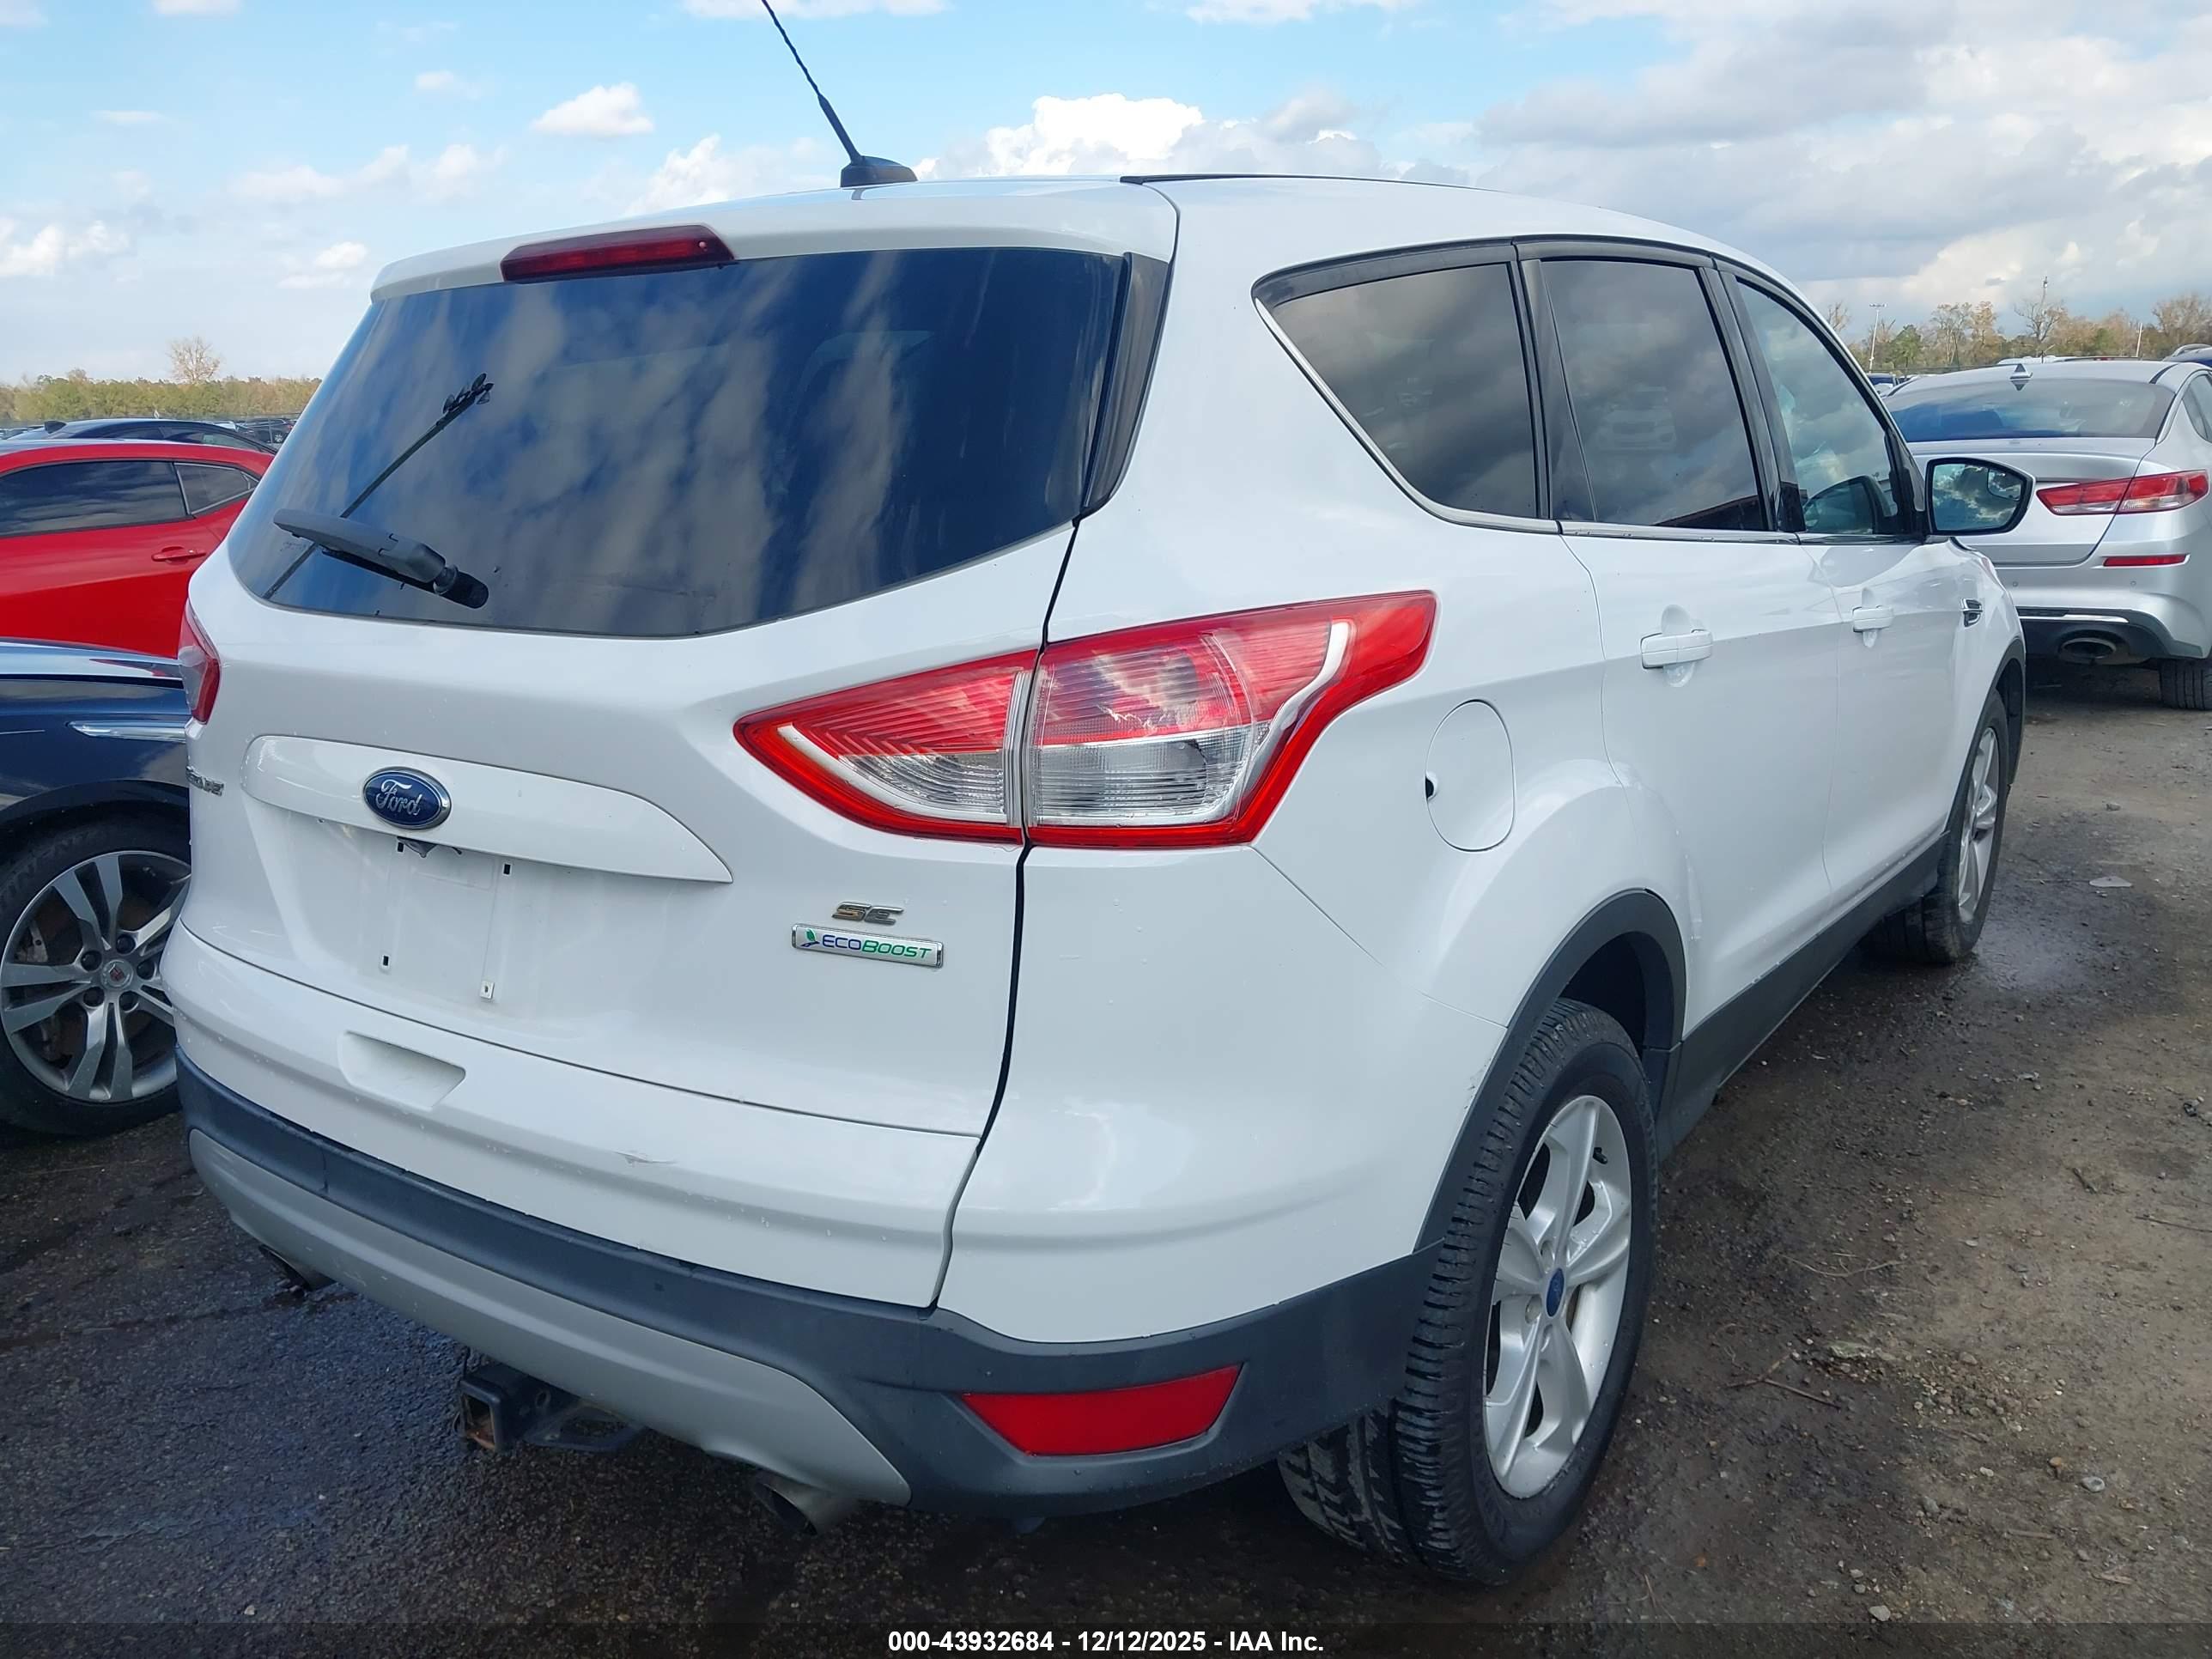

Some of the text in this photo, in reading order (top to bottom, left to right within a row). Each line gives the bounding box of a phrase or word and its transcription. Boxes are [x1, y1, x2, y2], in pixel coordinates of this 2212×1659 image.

[375, 779, 423, 816] Ford
[831, 901, 904, 926] SE
[822, 934, 933, 959] ECOBOOST
